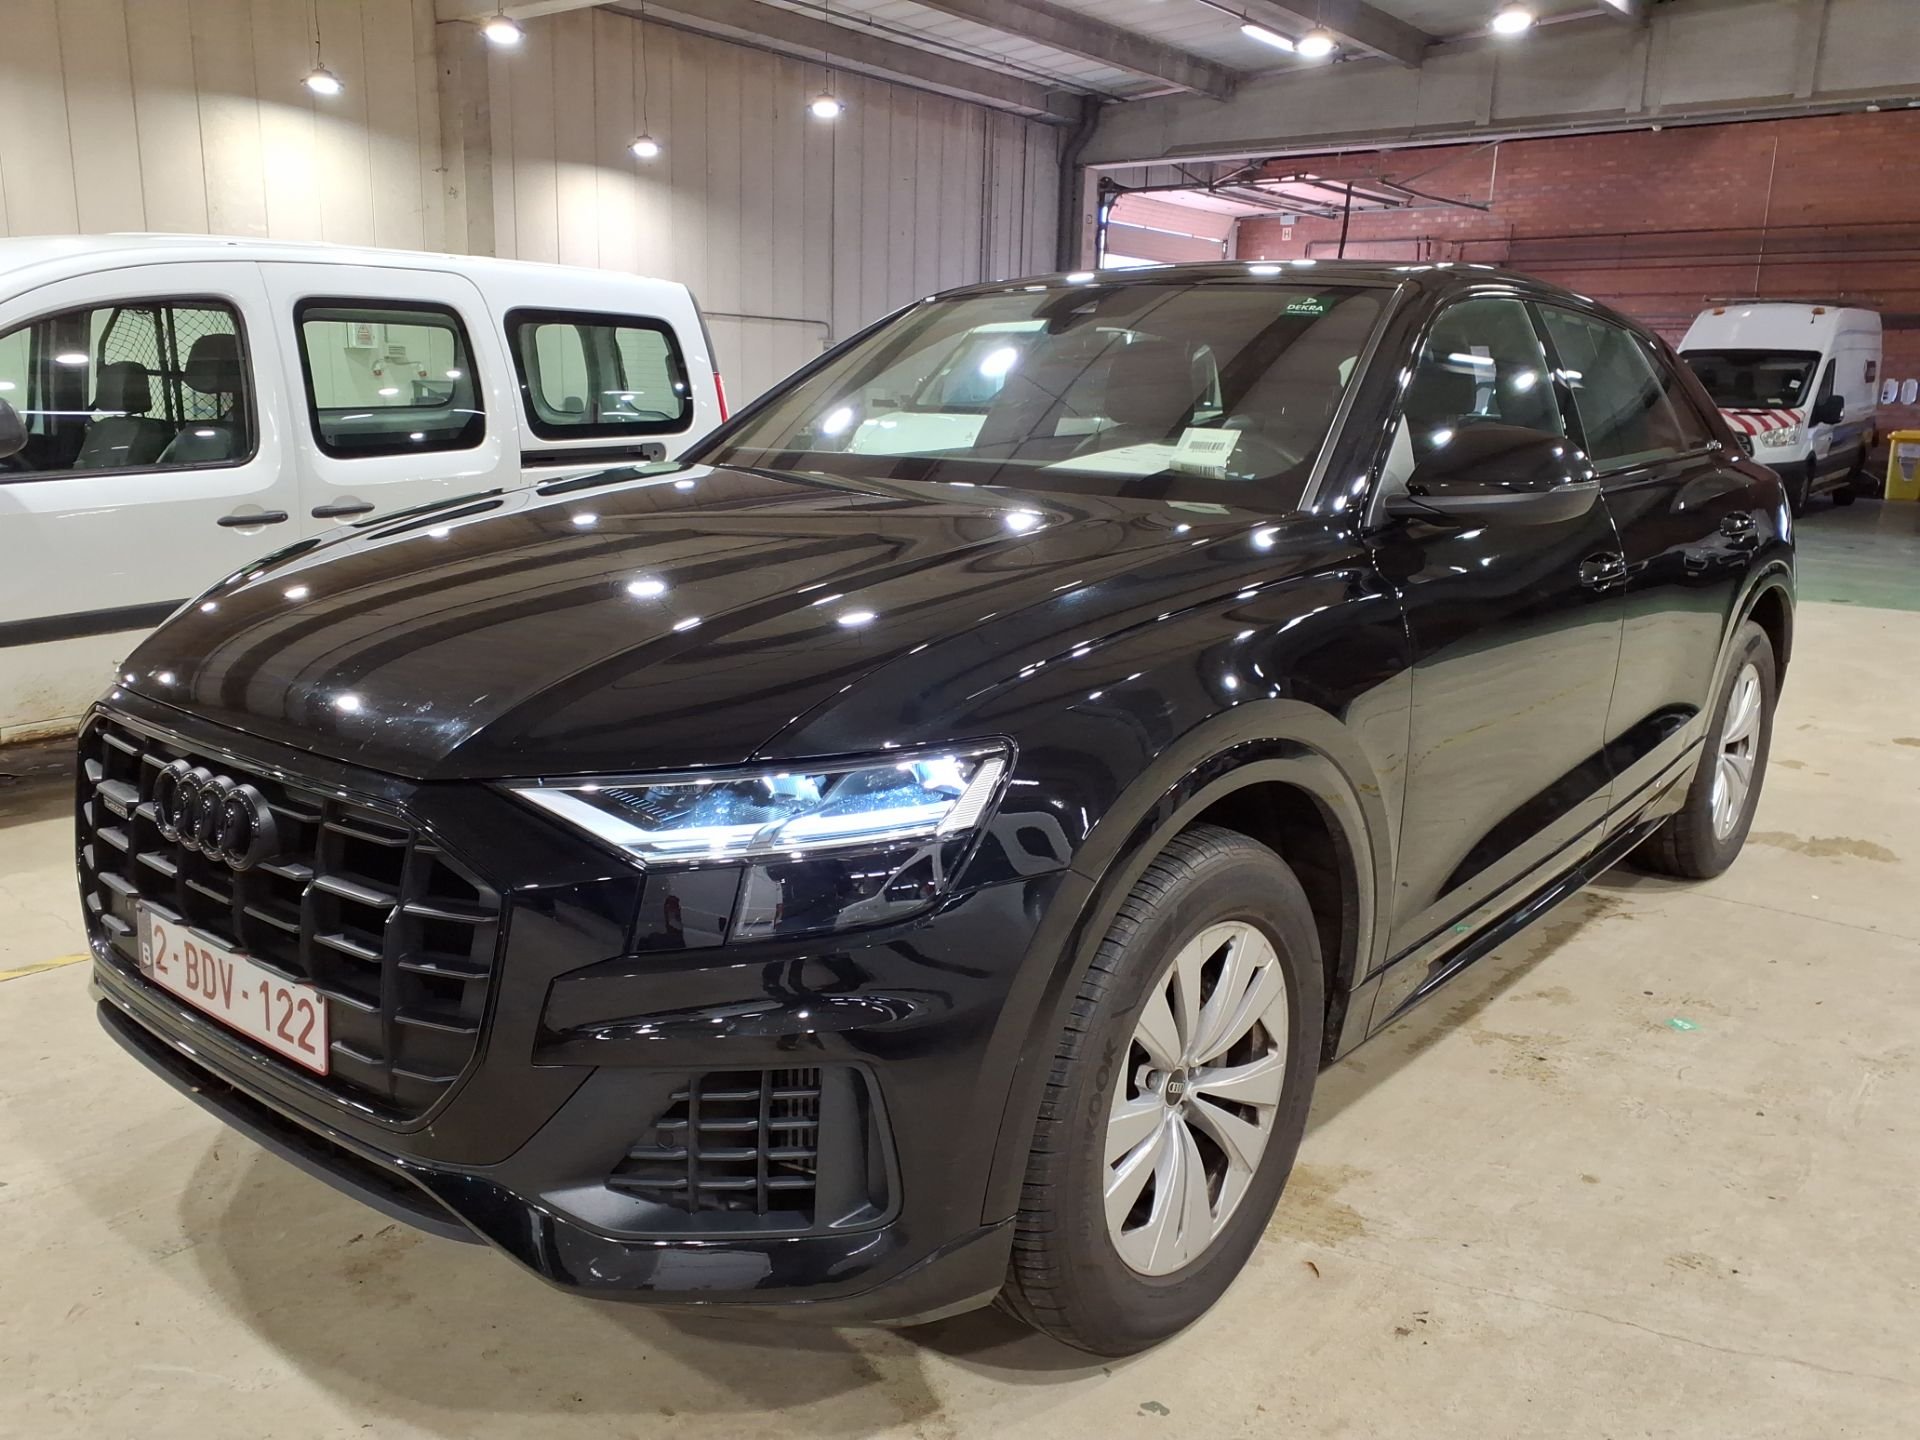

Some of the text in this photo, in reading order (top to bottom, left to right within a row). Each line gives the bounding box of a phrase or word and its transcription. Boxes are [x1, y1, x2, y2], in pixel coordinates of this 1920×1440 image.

[1286, 304, 1324, 312] DEKRA
[142, 942, 151, 966] B
[153, 924, 317, 1056] 2-BDV-122
